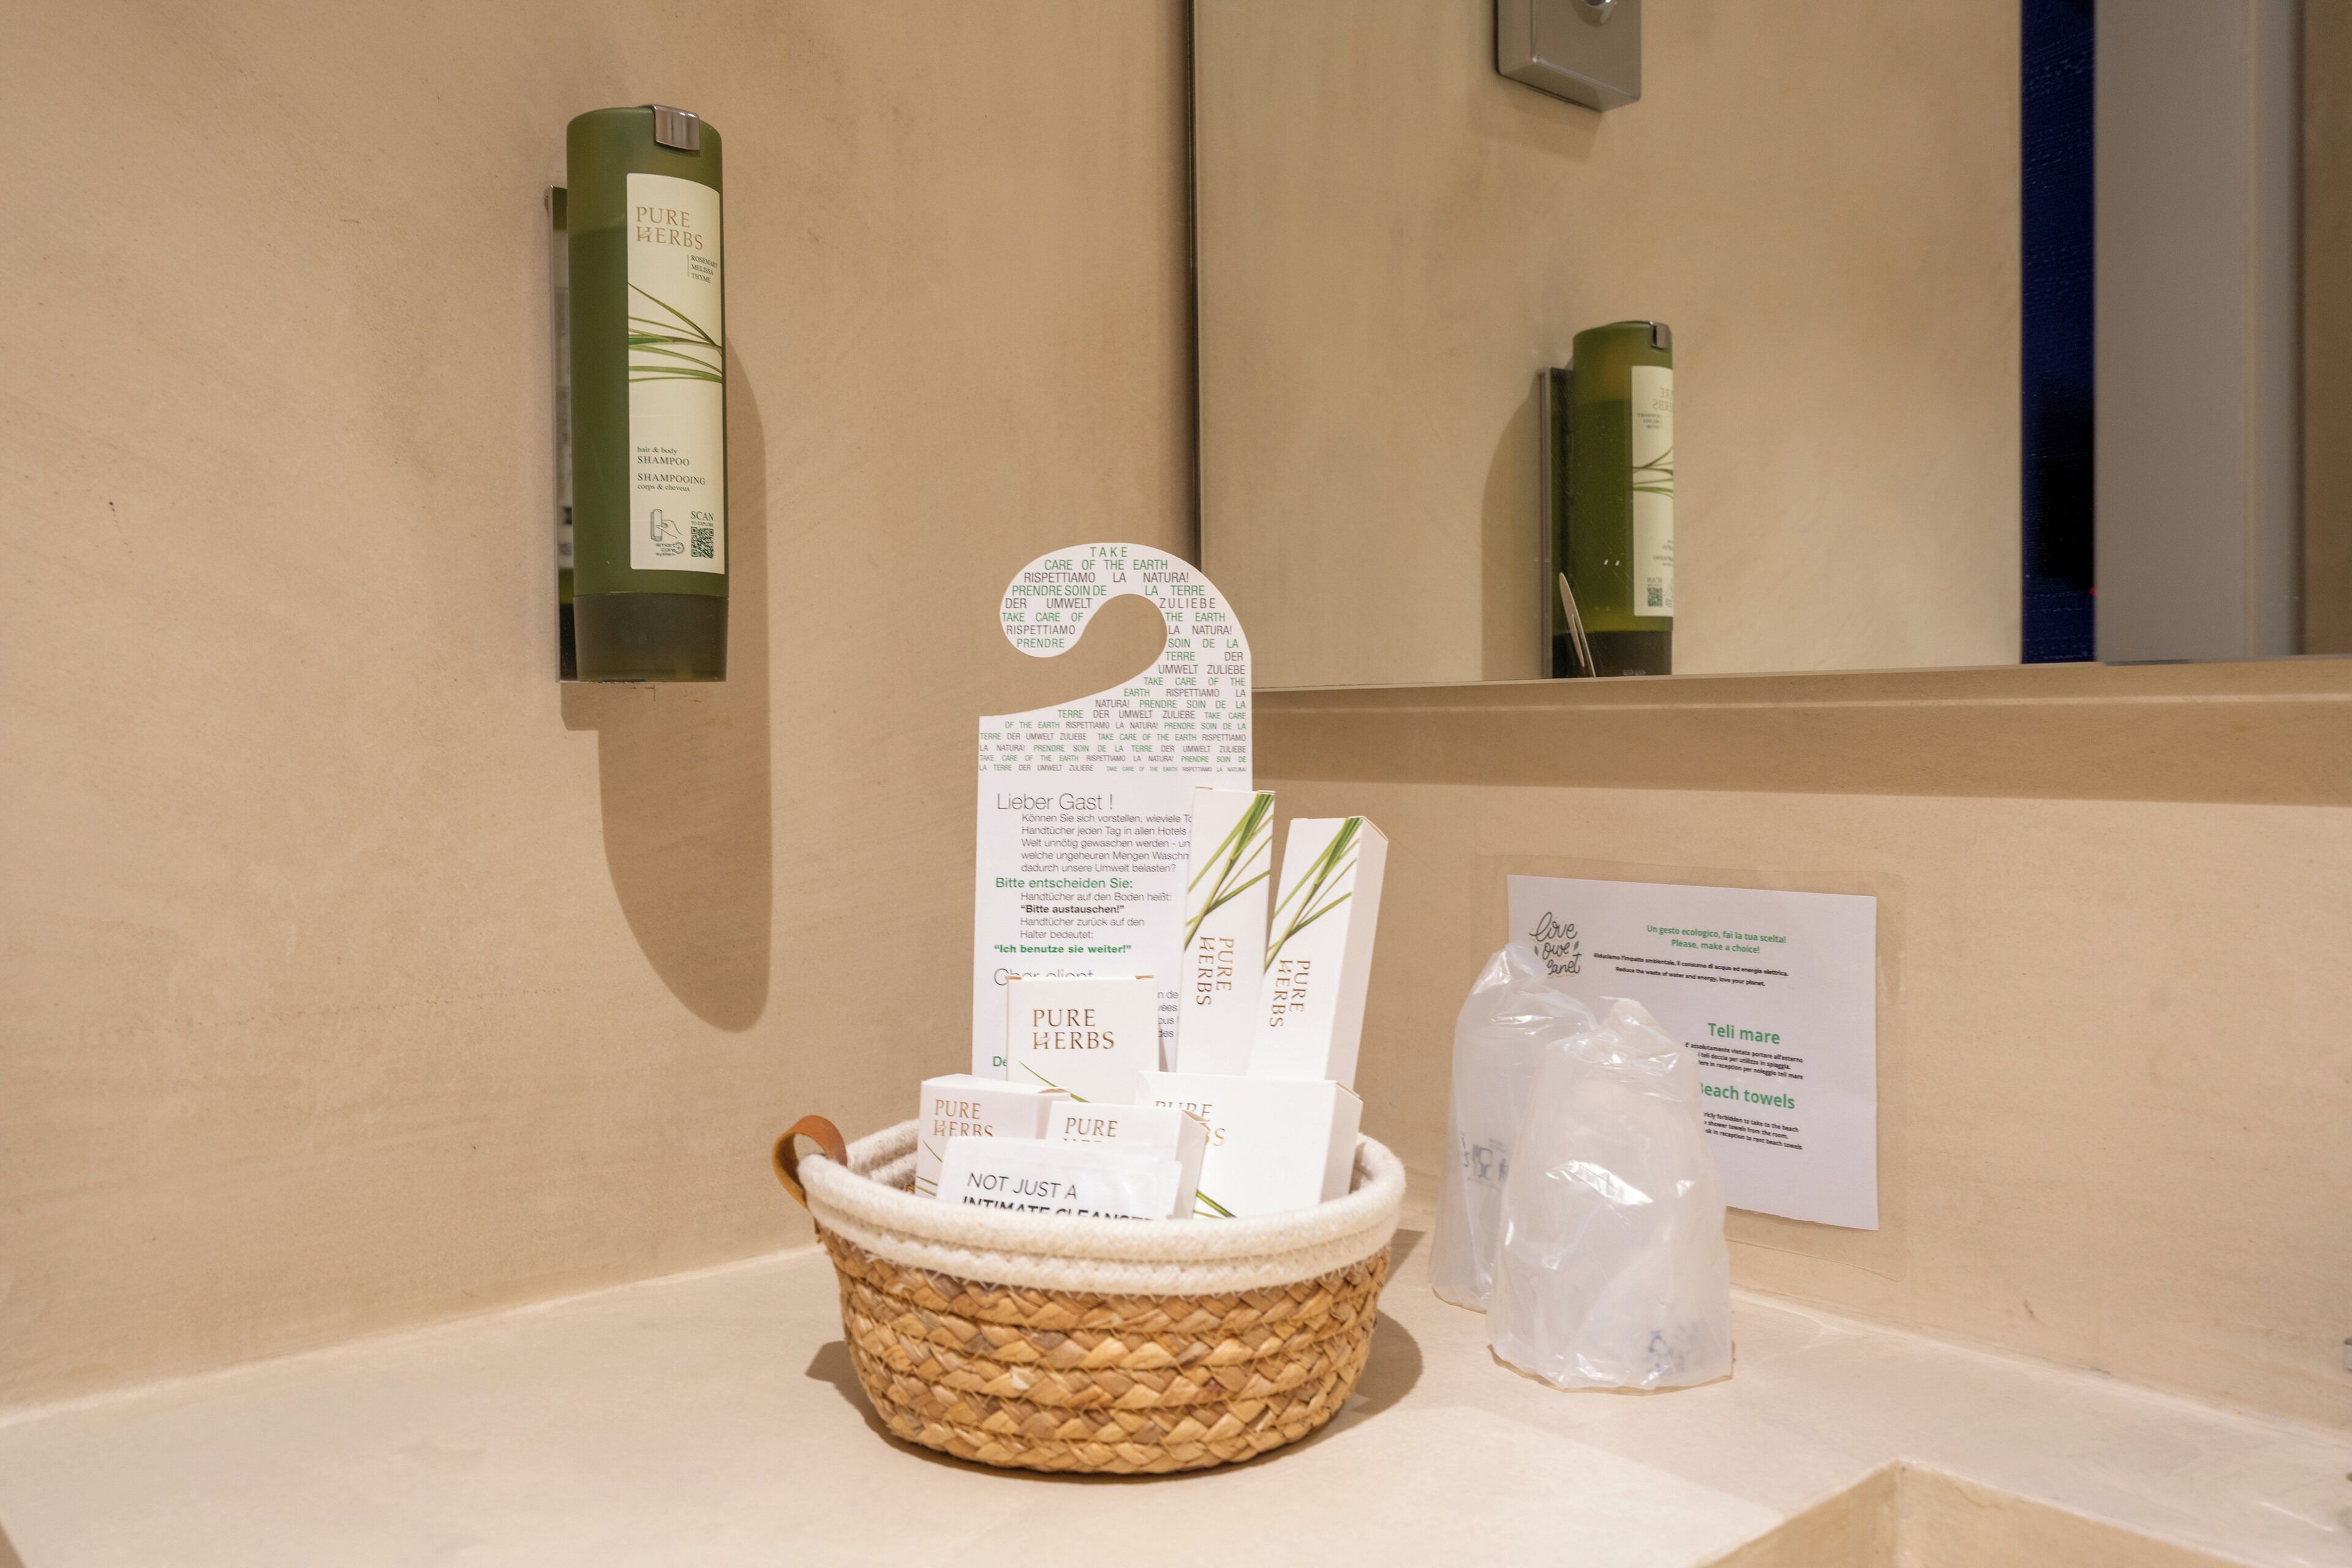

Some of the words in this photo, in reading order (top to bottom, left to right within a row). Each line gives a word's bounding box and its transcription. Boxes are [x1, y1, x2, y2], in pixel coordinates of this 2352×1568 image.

[636, 206, 690, 228] PURE
[636, 226, 703, 250] HERBS
[691, 255, 718, 268] ROSEMARY
[691, 264, 714, 275] MELISSA
[692, 273, 710, 283] THYME
[637, 456, 690, 466] SHAMPOO
[638, 473, 706, 484] SHAMPOOING
[691, 511, 714, 521] SCAN
[1090, 547, 1127, 557] TAKE
[1044, 559, 1073, 570] CARE
[1082, 559, 1096, 570] OF
[1103, 559, 1125, 570] THE
[1133, 559, 1167, 570] EARTH
[1024, 572, 1095, 582] RISPETTIAMO
[1113, 572, 1126, 582] LA
[1144, 572, 1188, 582] NATURA!
[1012, 585, 1062, 596] PRENDRE
[1065, 585, 1090, 596] SOIN
[1093, 585, 1107, 595] DE
[1145, 585, 1158, 595] LA
[1170, 585, 1205, 596] TERRE
[1006, 598, 1027, 608] DER
[1047, 598, 1093, 608] UMWELT
[1160, 598, 1216, 609] ZULIEBE
[1001, 612, 1024, 622] TAKE
[1036, 612, 1060, 622] CARE
[1071, 612, 1084, 622] OF
[1166, 612, 1183, 622] THE
[1196, 612, 1225, 622] EARTH
[1006, 625, 1075, 635] RISPETTIAMO
[1168, 625, 1180, 635] LA
[1192, 625, 1232, 635] NATURA!
[1017, 638, 1065, 648] PRENDRE
[1168, 638, 1190, 648] SOIN
[1202, 638, 1215, 648] DE
[1227, 639, 1238, 648] LA
[1165, 651, 1196, 661] TERRE
[1225, 652, 1243, 661] DER
[1158, 665, 1199, 674] UMWELT
[1207, 665, 1245, 674] ZULIEBE
[1143, 677, 1164, 685] TAKE
[1175, 677, 1196, 685] CARE
[1208, 677, 1219, 686] OF
[1230, 677, 1246, 686] THE
[998, 794, 1054, 810] Lieber
[1059, 793, 1102, 810] Gast
[1110, 794, 1112, 810] !
[1022, 813, 1057, 822] Können
[1060, 813, 1074, 822] Sie
[1098, 814, 1143, 823] vorstellen,
[1077, 826, 1102, 836] jeden
[1105, 826, 1121, 837] Tag
[1044, 839, 1078, 849] unnötig
[1081, 839, 1133, 849] gewaschen
[1056, 851, 1110, 861] ungeheuren
[1113, 851, 1150, 862] Mengen
[1021, 864, 1059, 872] dadurch
[1095, 864, 1129, 872] Umwelt
[1133, 864, 1176, 872] belasten?
[996, 878, 1025, 888] Bitte
[1029, 878, 1106, 888] entscheiden
[1110, 878, 1133, 888] Sie:
[1077, 892, 1091, 901] auf
[1114, 892, 1144, 901] Boden
[1147, 892, 1171, 901] heißt:
[1020, 918, 1074, 926] Handtücher
[1077, 918, 1107, 926] zurück
[1110, 918, 1125, 926] auf
[1127, 918, 1144, 926] den
[1529, 911, 1578, 941] love
[1681, 929, 1721, 938] ecologico,
[1759, 935, 1786, 943] scelta!
[1672, 940, 1698, 949] Please,
[1732, 944, 1760, 953] choice!
[1216, 938, 1234, 990] PURE
[1196, 937, 1215, 1005] HERBS
[1289, 960, 1311, 1012] PURE
[1270, 960, 1293, 1027] HERBS
[1033, 1009, 1095, 1027] PURE
[1708, 1023, 1734, 1039] Teli
[1740, 1030, 1780, 1044] mare
[1033, 1031, 1114, 1049] HERBS
[1744, 1089, 1795, 1109] towels
[935, 1099, 981, 1119] PURE
[933, 1120, 993, 1137] HERBS
[1065, 1117, 1118, 1137] PURE
[967, 1172, 1009, 1191] NOT
[1013, 1178, 1061, 1198] JUST
[1065, 1186, 1077, 1199] A
